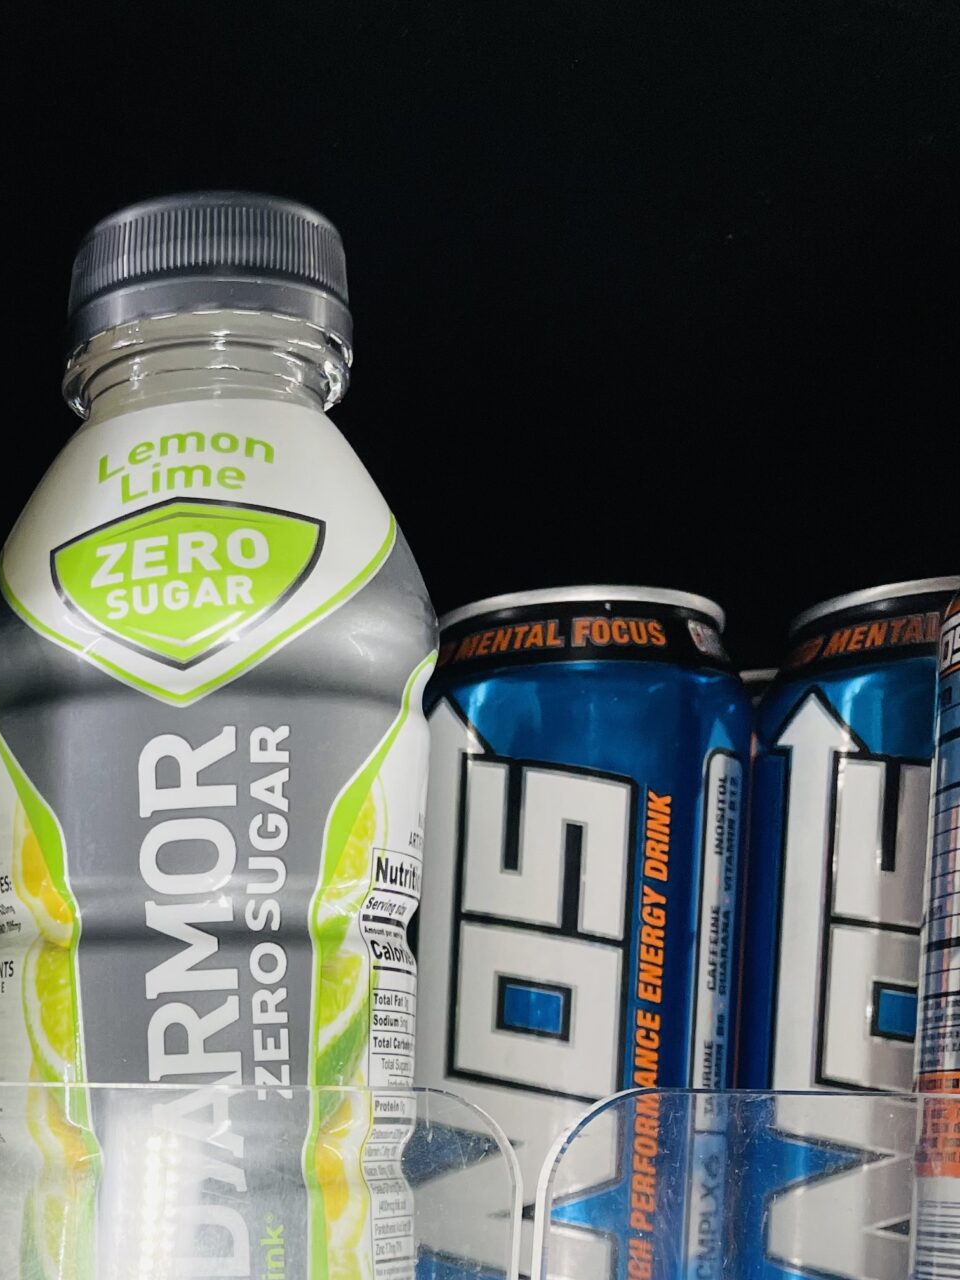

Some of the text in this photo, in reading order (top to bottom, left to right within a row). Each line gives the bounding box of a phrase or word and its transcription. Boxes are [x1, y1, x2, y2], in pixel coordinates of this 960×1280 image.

[98, 431, 274, 484] Lemon
[120, 462, 246, 504] Lime
[91, 528, 270, 588] ZERO
[106, 575, 254, 620] SUGAR
[455, 617, 667, 660] MENTAL FOCUS
[643, 790, 672, 881] DRINK
[245, 725, 293, 1100] ZERO SUGAR
[637, 882, 669, 1003] ENERGY
[373, 993, 393, 1006] Total
[373, 1015, 399, 1027] Sodium
[373, 1037, 392, 1049] Total
[375, 1100, 399, 1112] Protein
[630, 1007, 662, 1231] PERFORMANCE
